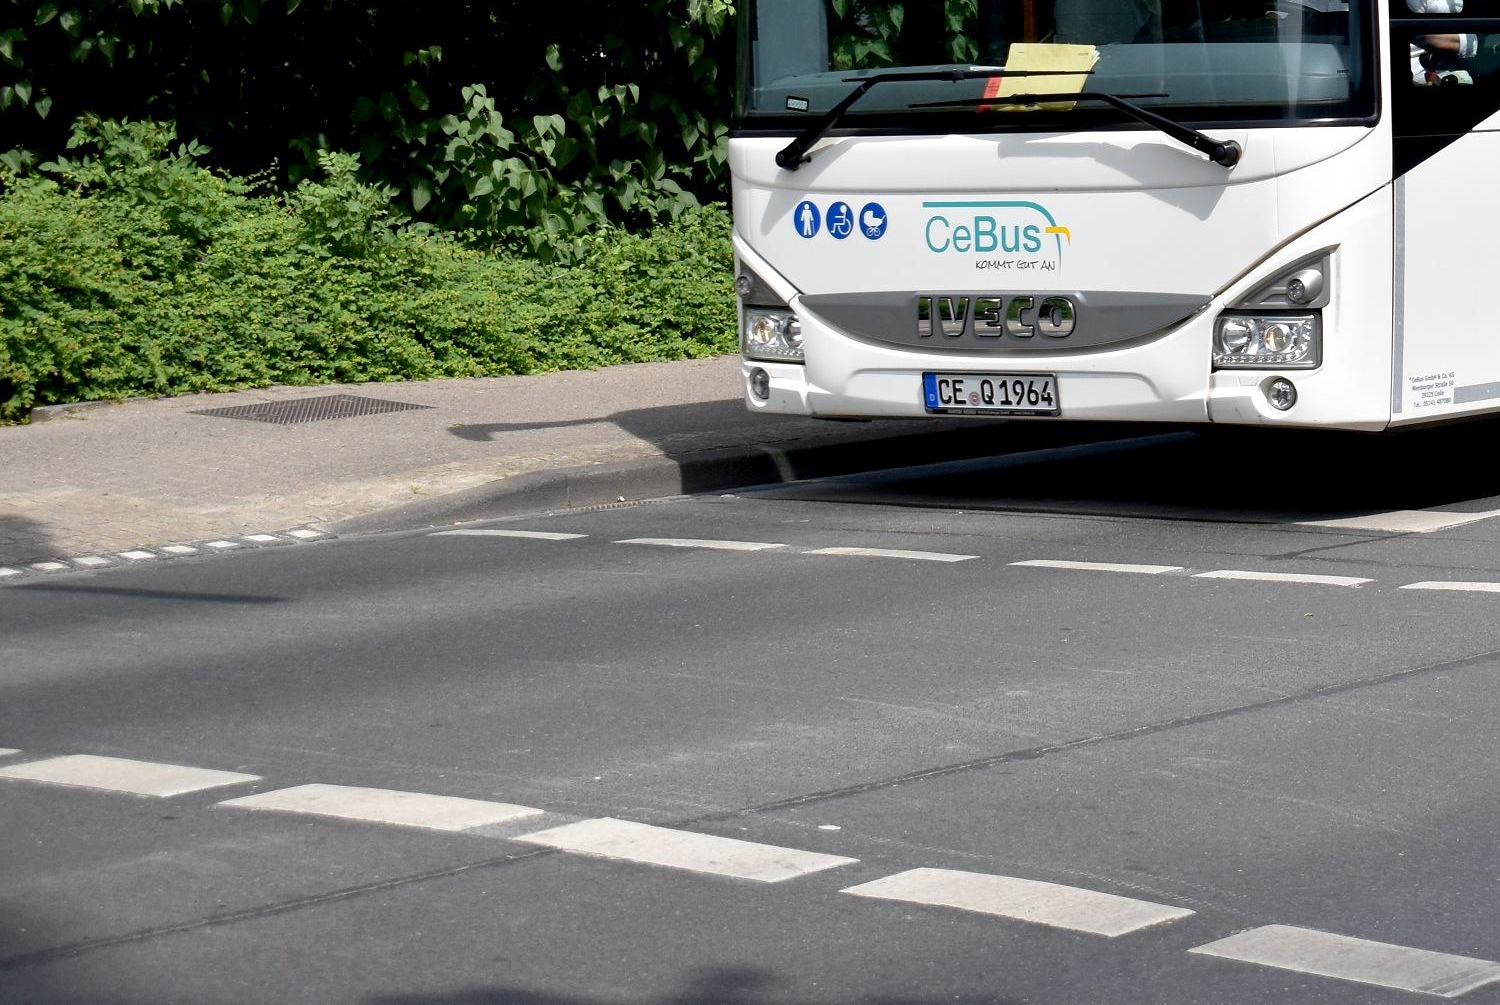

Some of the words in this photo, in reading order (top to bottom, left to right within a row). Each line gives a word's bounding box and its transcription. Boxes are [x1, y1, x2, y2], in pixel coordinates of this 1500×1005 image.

[925, 215, 1042, 253] CeBus
[976, 260, 1014, 270] KOMMT
[1040, 260, 1056, 271] AN
[917, 296, 1077, 339] IVECO
[938, 379, 966, 405] CE
[980, 379, 994, 405] Q
[998, 380, 1053, 406] 1964
